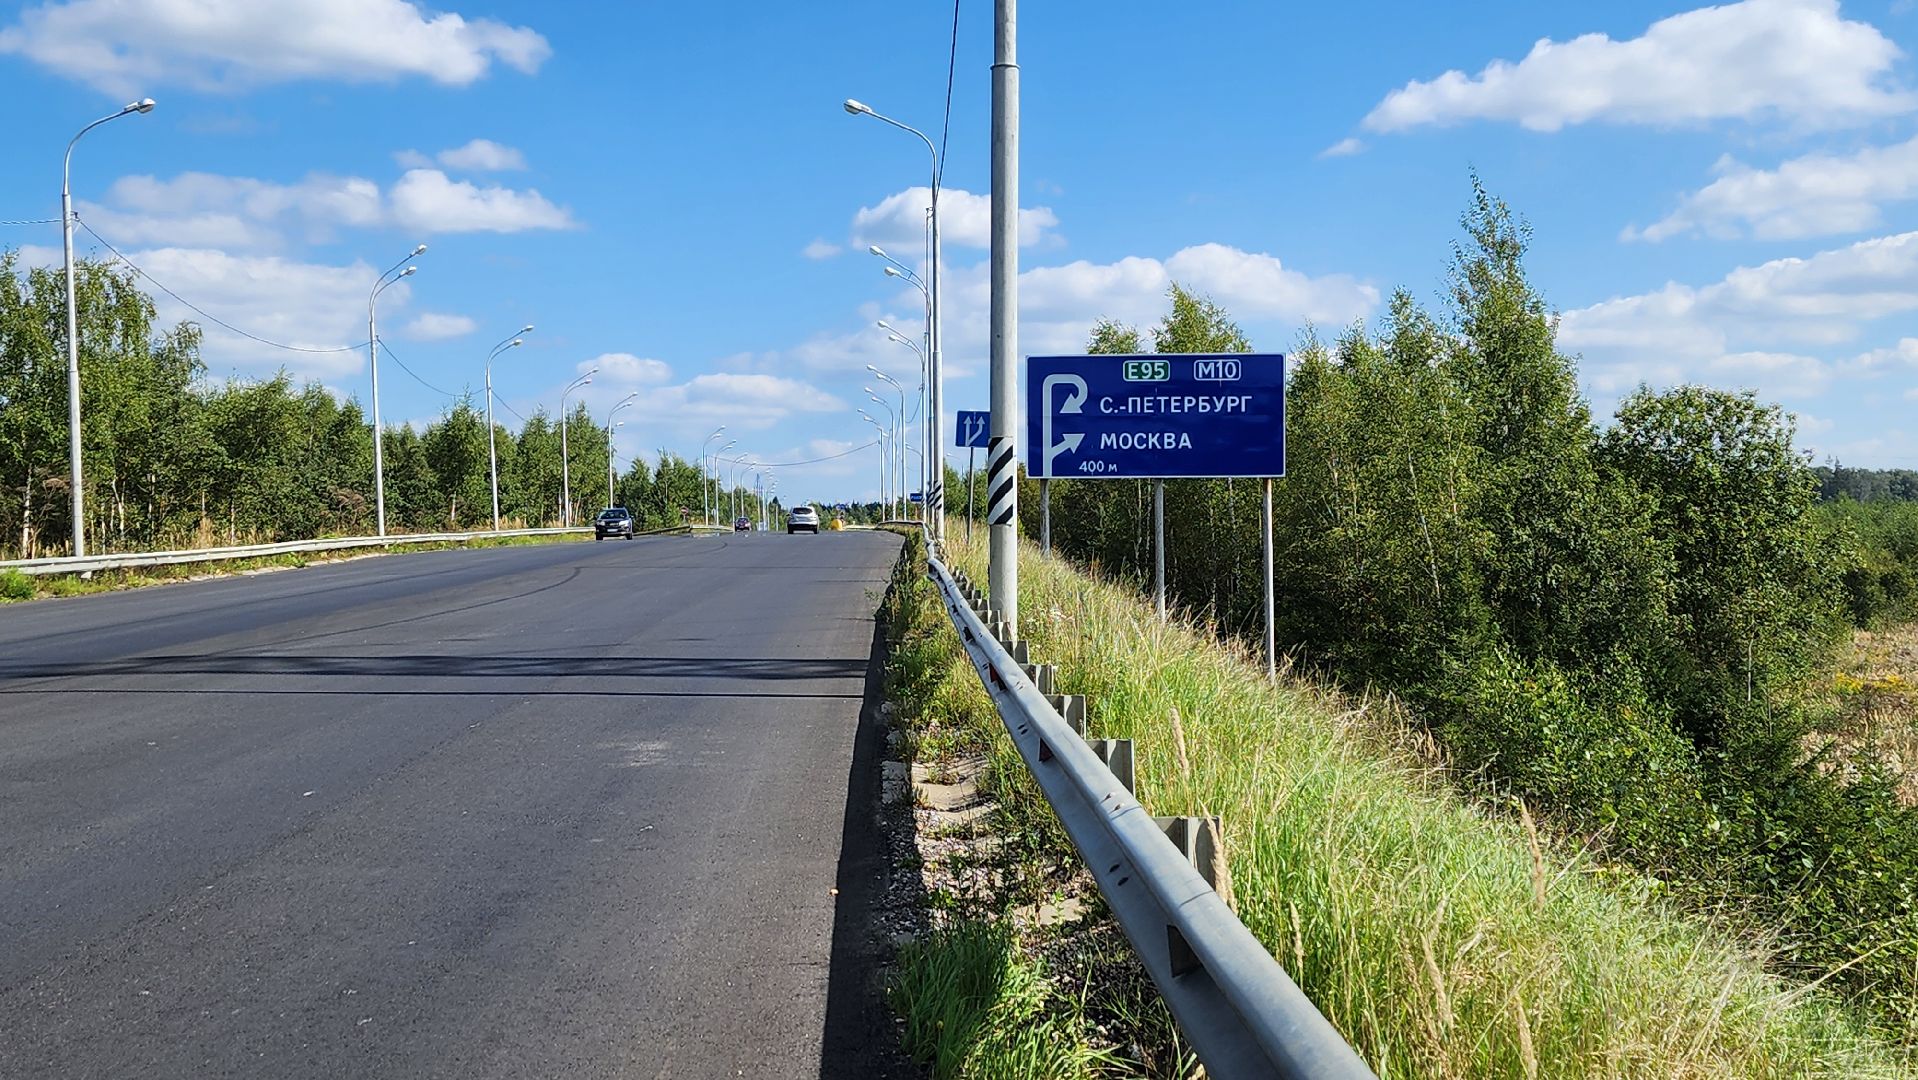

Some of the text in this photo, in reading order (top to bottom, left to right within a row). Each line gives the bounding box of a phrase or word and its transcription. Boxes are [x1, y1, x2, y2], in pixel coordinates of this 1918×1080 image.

[1128, 362, 1165, 379] E95
[1198, 362, 1237, 379] М10
[1100, 396, 1253, 413] С.-ПЕТЕРБУРГ
[1100, 432, 1193, 449] МОСКВА
[1079, 460, 1118, 473] 400 м
